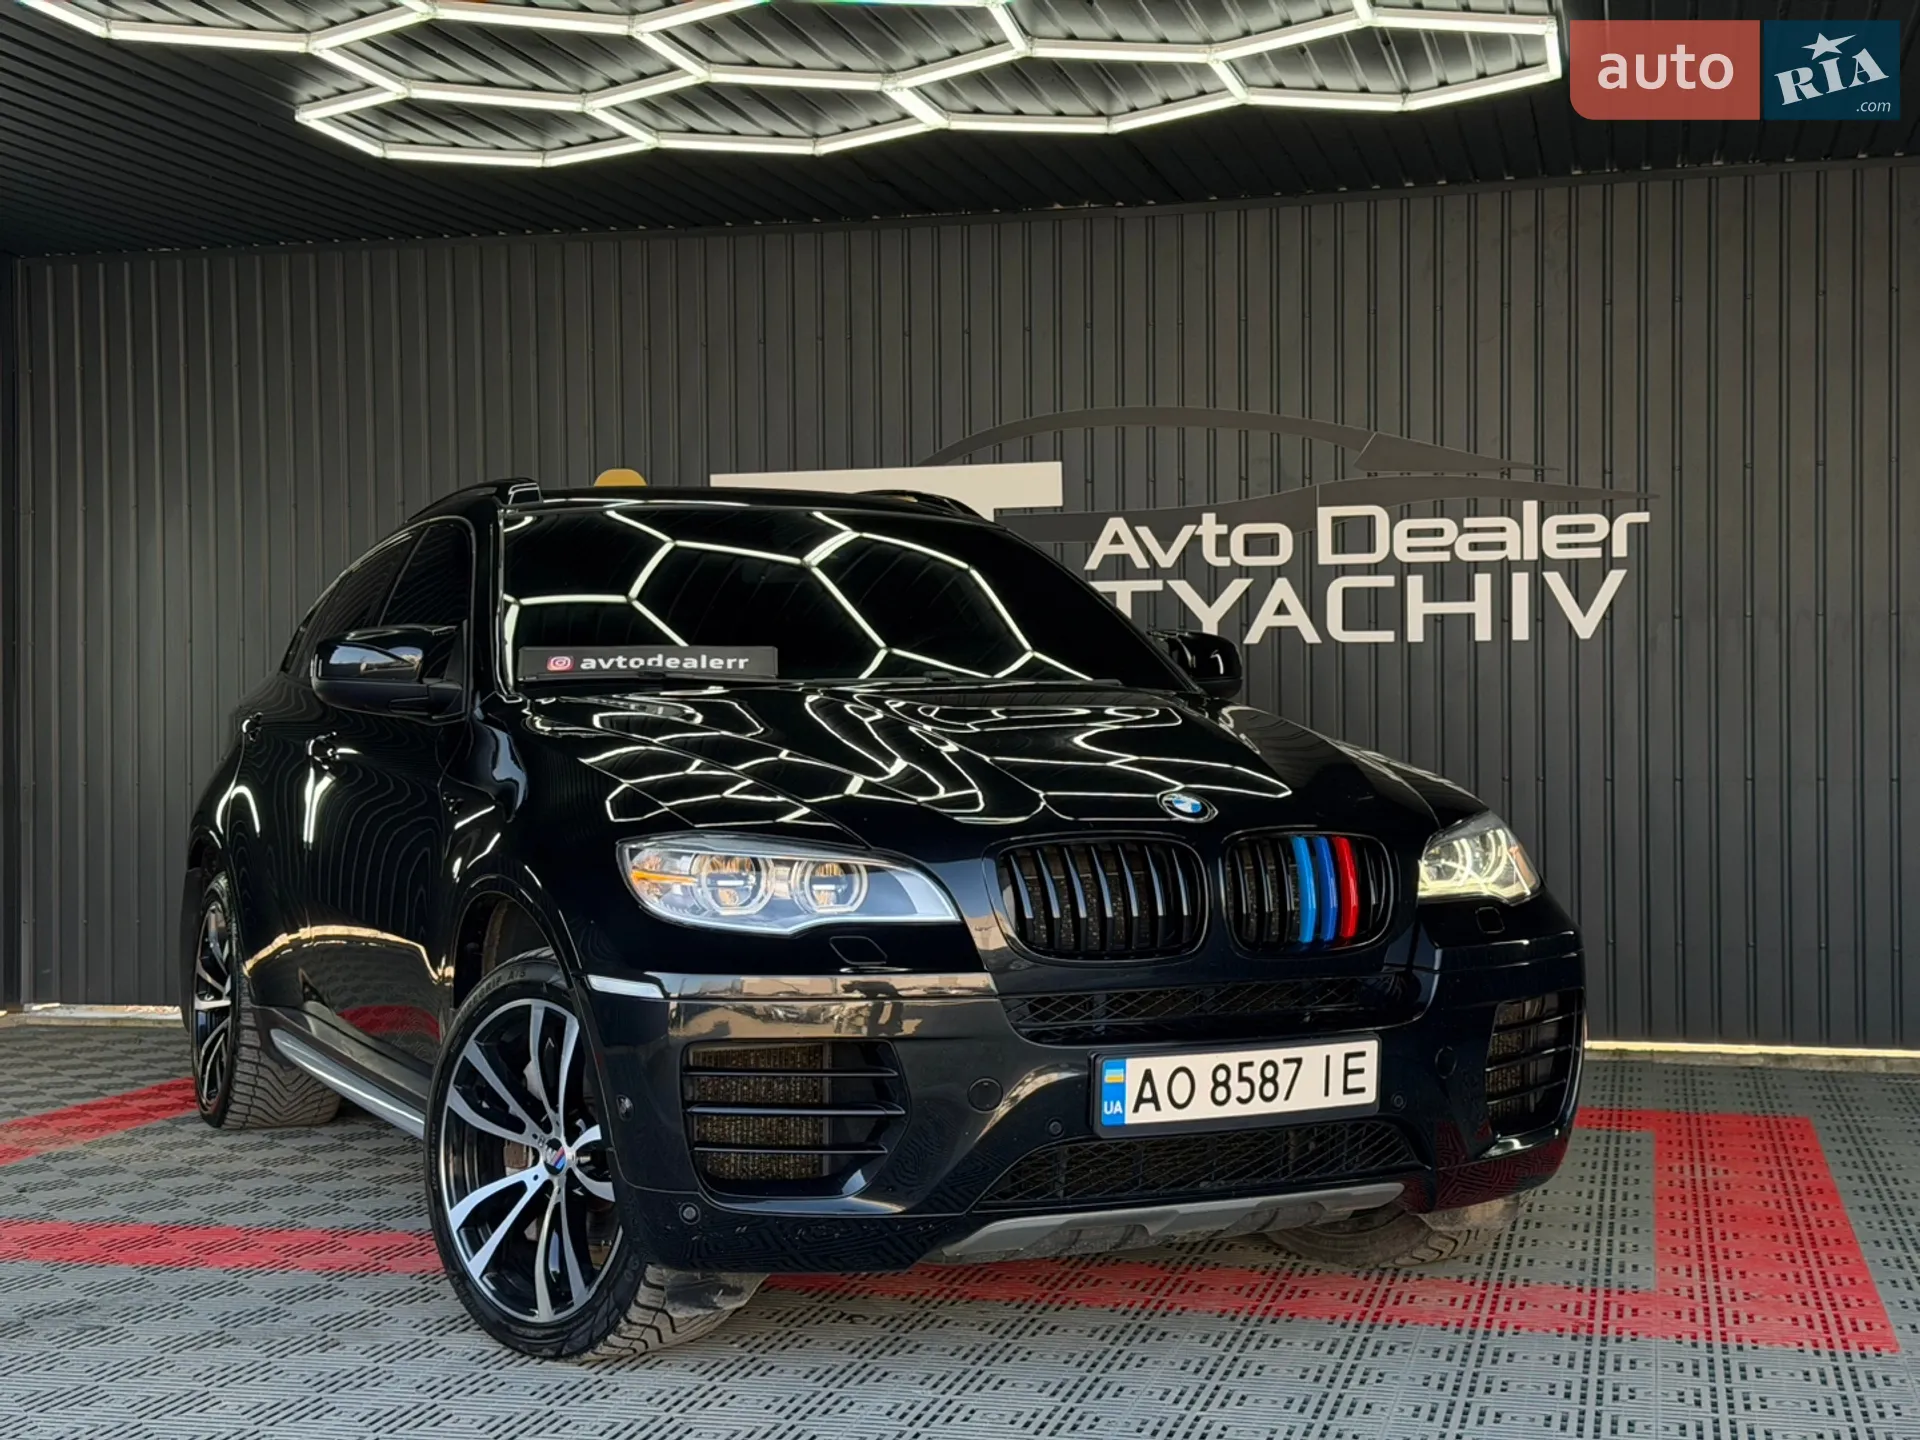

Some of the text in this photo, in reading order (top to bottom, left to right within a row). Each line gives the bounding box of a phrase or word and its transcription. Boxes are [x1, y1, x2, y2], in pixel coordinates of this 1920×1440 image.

[1083, 500, 1651, 571] Avto Dealer
[1088, 569, 1628, 645] TYACHIV
[579, 653, 750, 671] avtodealerr
[1103, 1100, 1124, 1115] UA
[1131, 1050, 1367, 1114] AO 8587 IE
